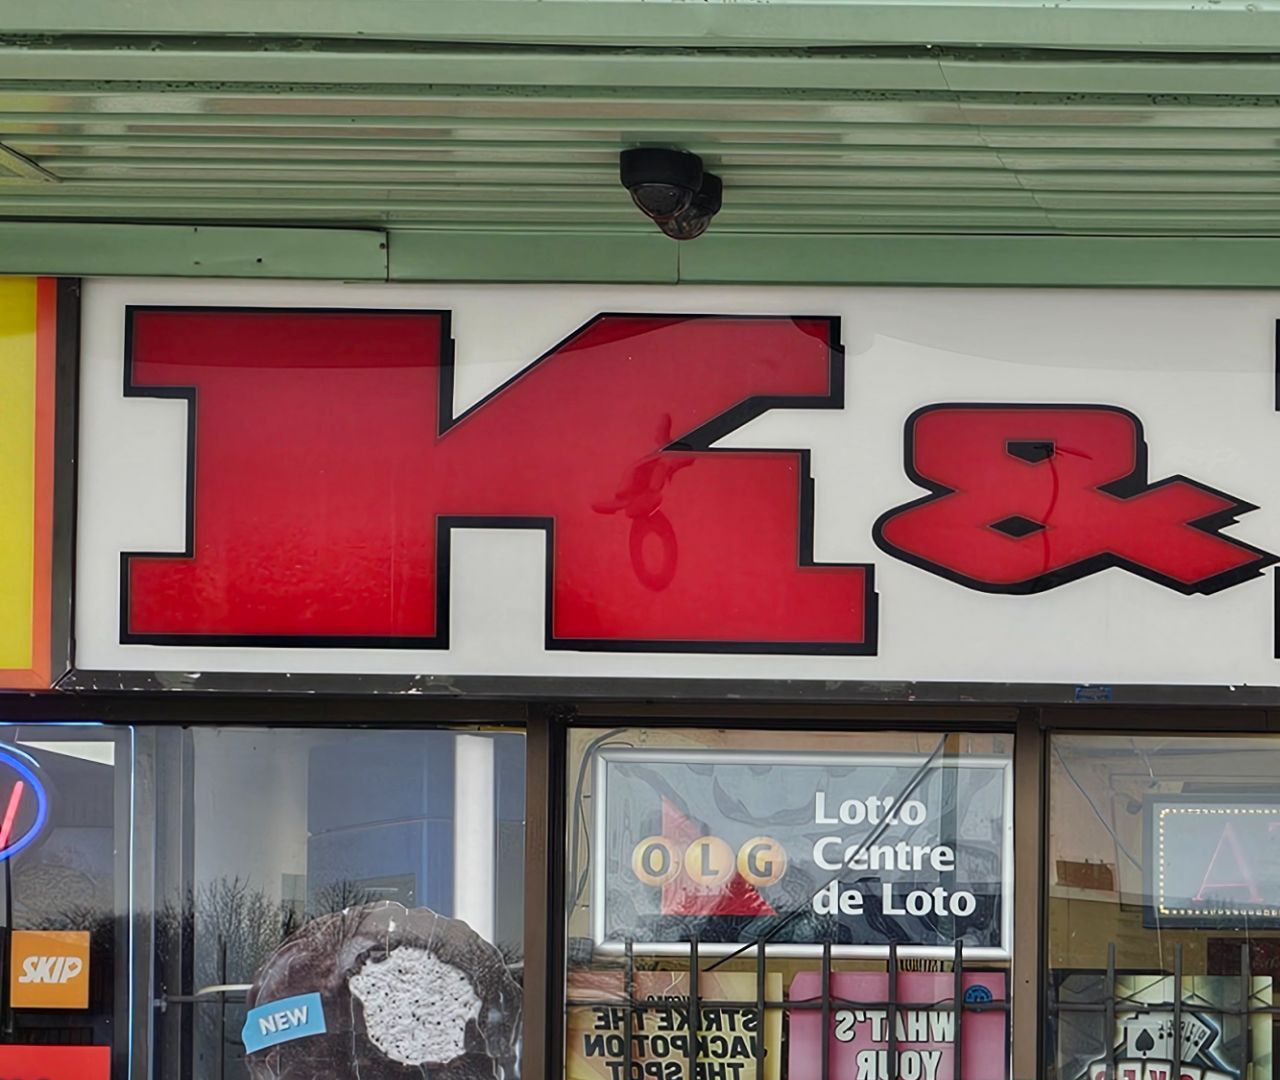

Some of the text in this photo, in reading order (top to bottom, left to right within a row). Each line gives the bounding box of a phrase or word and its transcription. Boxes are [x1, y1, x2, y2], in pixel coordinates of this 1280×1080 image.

[120, 306, 876, 657] K
[815, 792, 927, 825] Lotto
[813, 837, 955, 871] Centre
[813, 881, 976, 916] de Loto
[18, 956, 82, 984] SKIP
[259, 1005, 309, 1036] NEW
